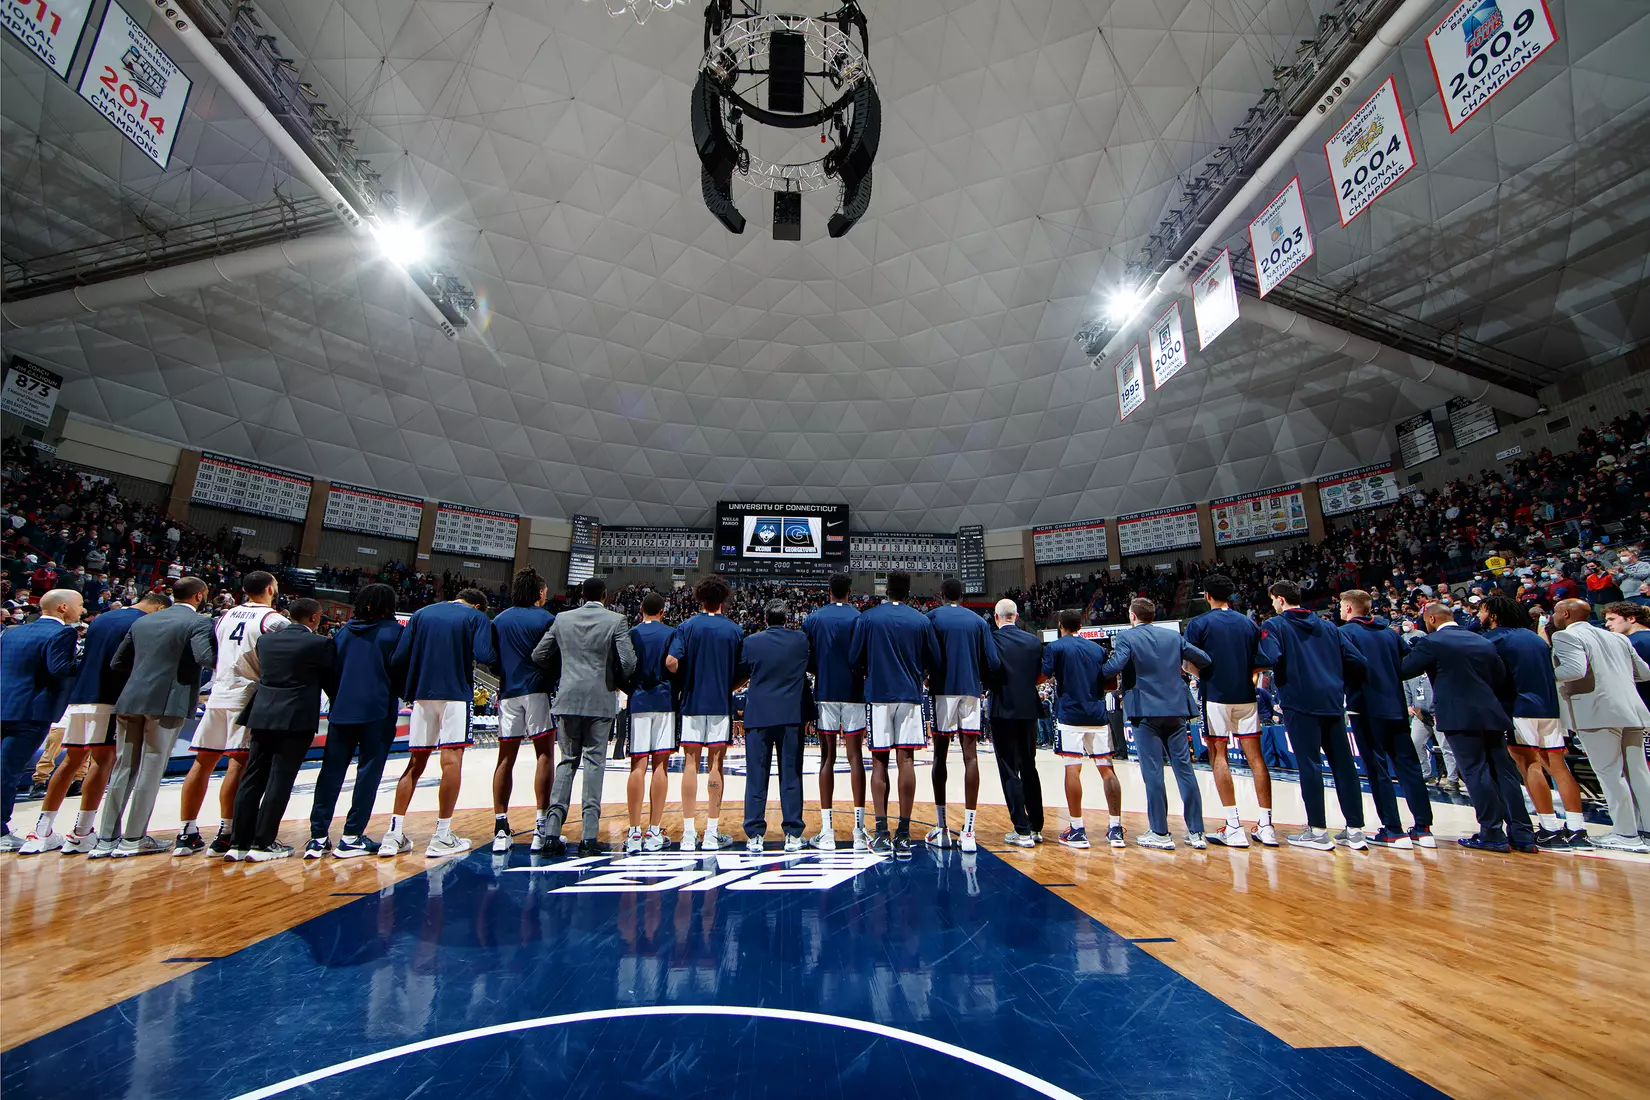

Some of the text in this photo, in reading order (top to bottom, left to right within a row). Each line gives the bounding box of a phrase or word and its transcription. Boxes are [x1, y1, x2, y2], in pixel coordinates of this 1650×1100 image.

[16, 0, 62, 36] 11
[1435, 4, 1465, 36] UConn
[125, 17, 154, 50] UConn
[155, 49, 178, 75] Men's
[1466, 16, 1502, 57] FOUR
[128, 30, 171, 77] Basketball
[1449, 8, 1535, 100] 2009
[1460, 43, 1541, 117] CHAMPIONS
[1462, 40, 1531, 102] NATIONAL
[100, 66, 165, 136] 2014
[91, 95, 159, 159] CHAMPIONS
[100, 88, 157, 146] NATIONAL
[1331, 122, 1353, 145] UConn
[1353, 87, 1386, 121] Women's
[1342, 104, 1377, 142] Basketball
[1341, 133, 1401, 200] 2004
[1349, 164, 1405, 216] CHAMPIONS
[1350, 160, 1399, 204] NATIONAL
[1261, 225, 1303, 274] 2003
[1266, 248, 1302, 280] NATIONAL
[1265, 253, 1306, 291] CHAMPIONS
[28, 364, 50, 377] COACH
[1155, 340, 1182, 373] 2000
[15, 365, 58, 387] JIM CALHOUN
[16, 374, 51, 397] 873
[1122, 380, 1140, 403] 1995
[43, 444, 57, 454] 223
[1505, 447, 1521, 457] 207
[196, 481, 210, 489] 2007
[201, 463, 214, 471] 1989
[252, 475, 263, 483] 1994
[203, 459, 237, 470] REGULAR
[272, 474, 311, 486] CHAMPIONS
[1318, 463, 1391, 483] NCAA CHAMPIONS
[212, 494, 289, 514] 2017 2021
[786, 504, 837, 512] CONNECTICUT
[1214, 485, 1295, 505] NCAA CHAMPIONSHIP
[465, 507, 515, 517] CHAMPIONSHIP
[1055, 520, 1101, 529] CHAMPIONSHIP
[1141, 505, 1192, 517] CHAMPIONSHIP
[229, 610, 258, 620] MARTIN
[229, 621, 247, 646] 4
[1079, 631, 1098, 639] SOBER
[547, 868, 867, 894] BIG
